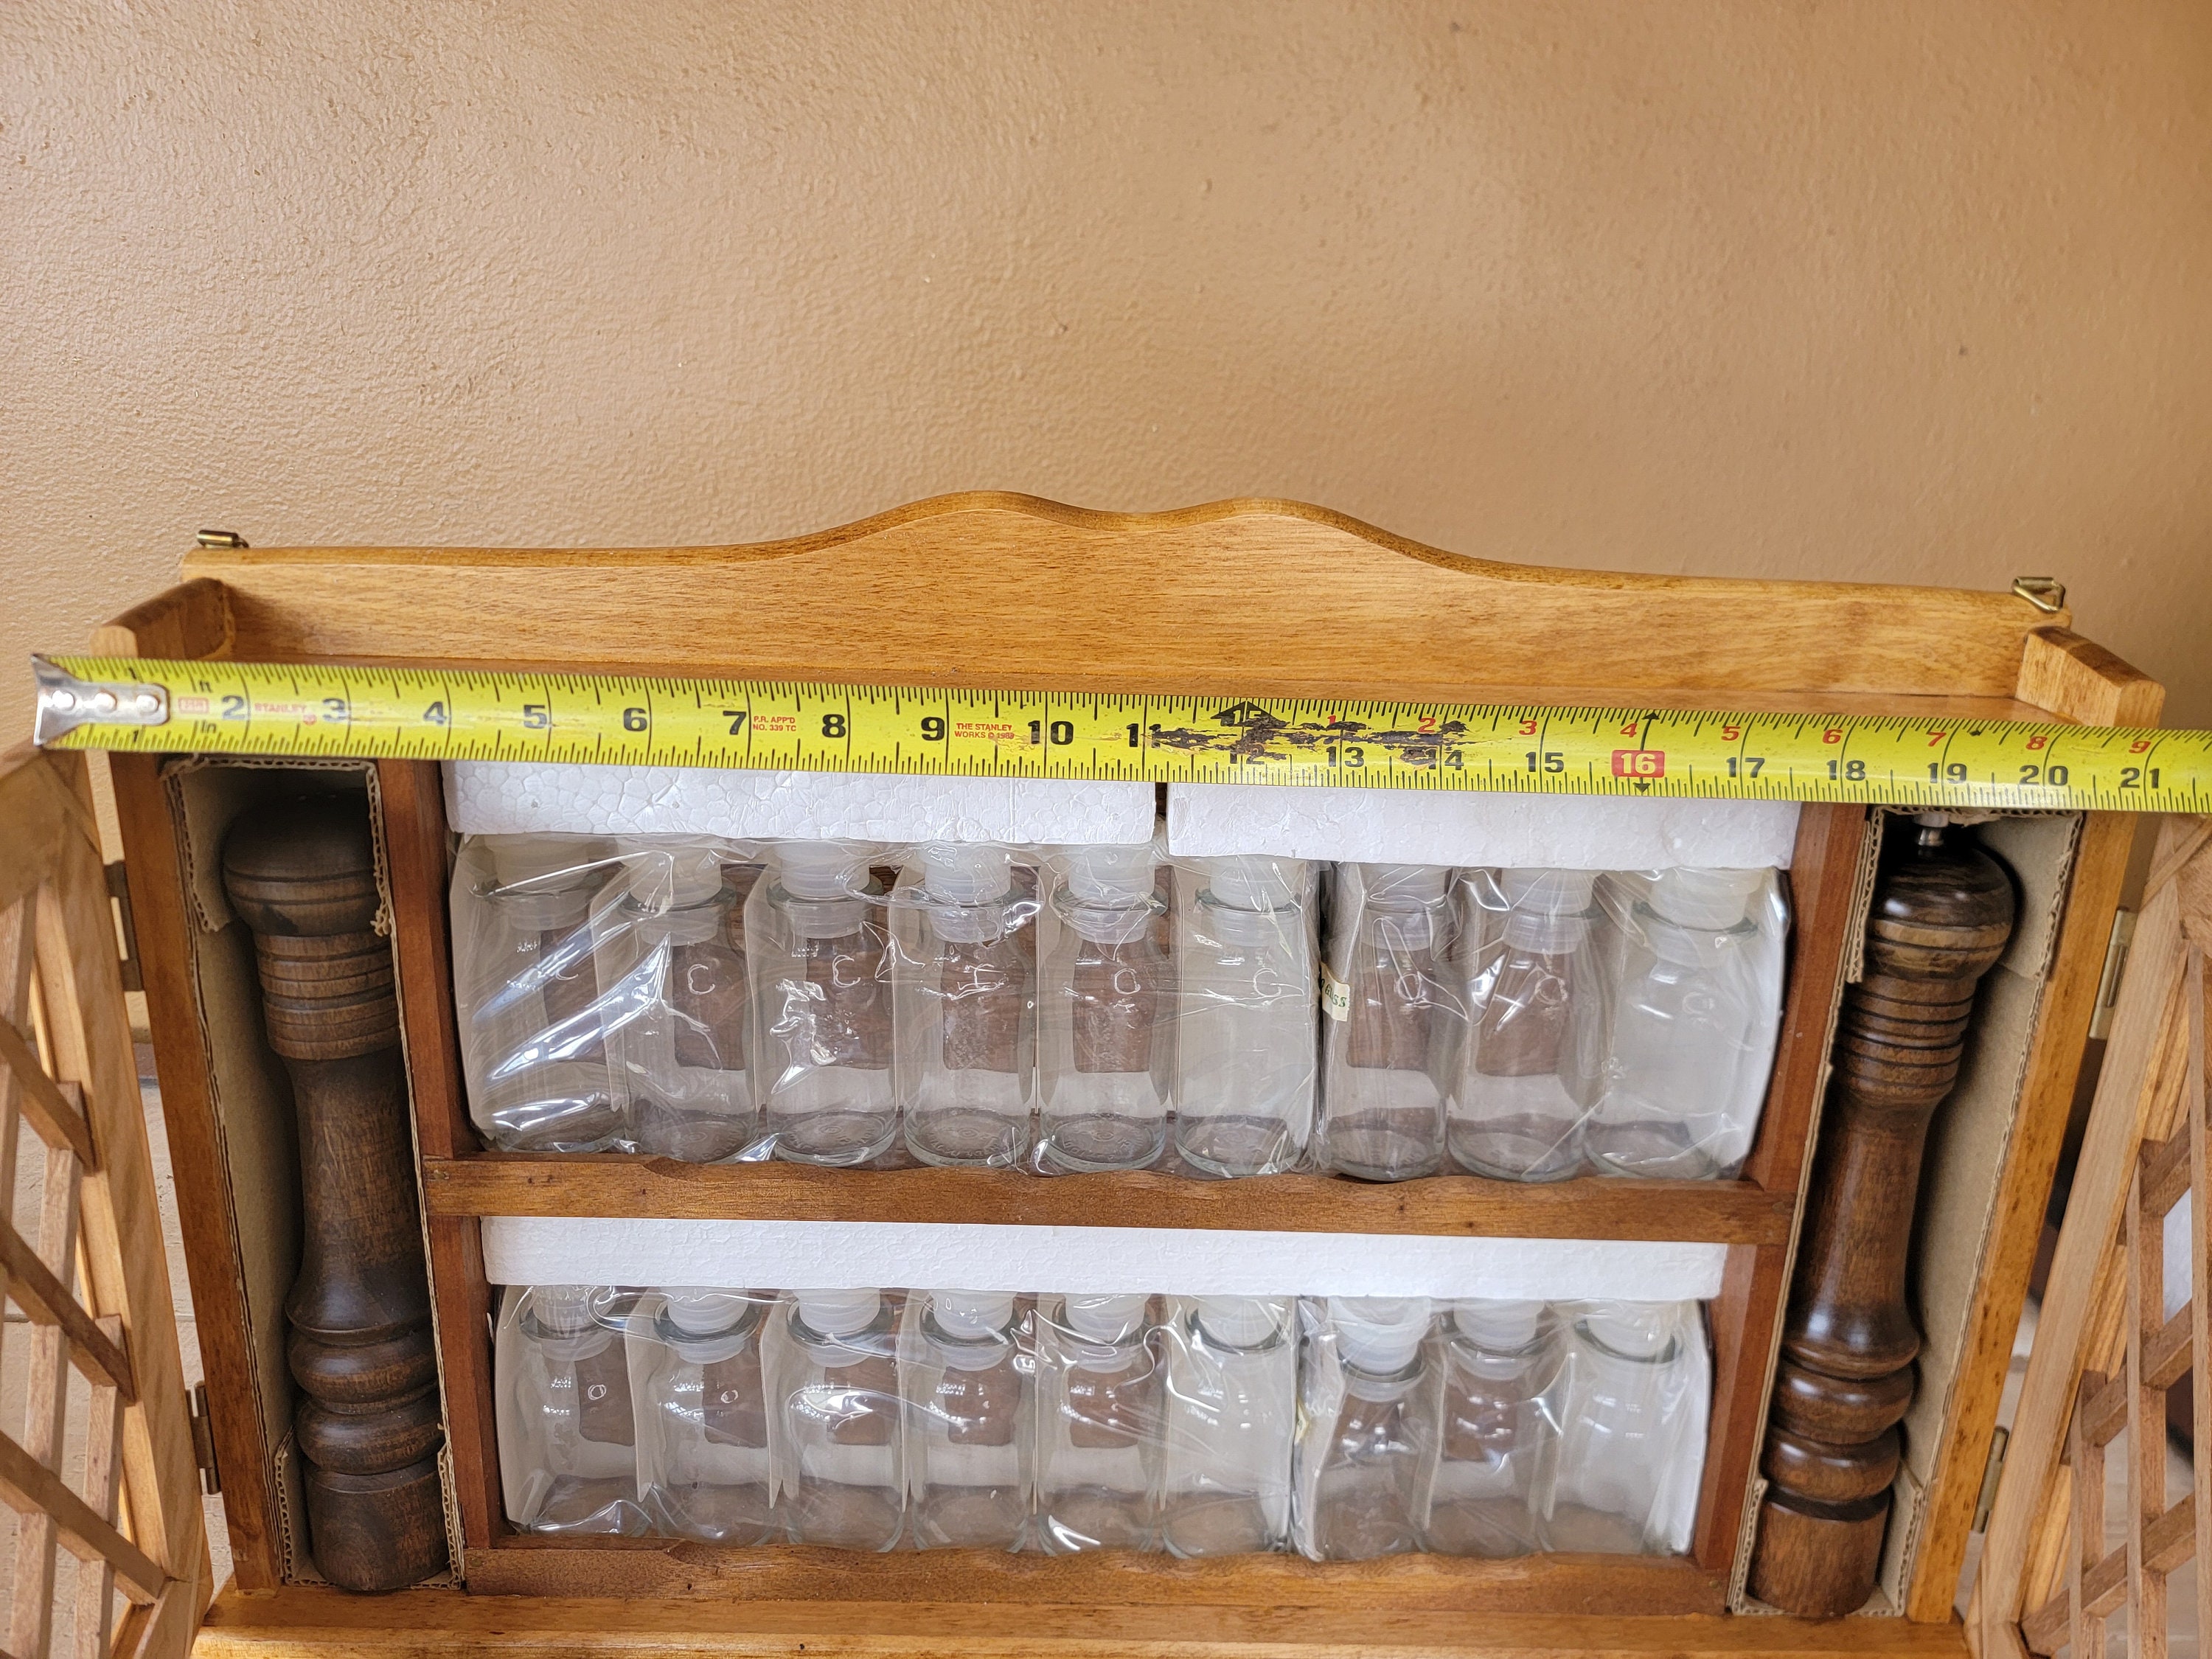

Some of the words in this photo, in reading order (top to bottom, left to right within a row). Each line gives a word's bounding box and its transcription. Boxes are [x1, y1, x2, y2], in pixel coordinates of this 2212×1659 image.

[223, 695, 244, 720] 2
[322, 698, 347, 723] 3
[422, 701, 447, 726] 4
[523, 704, 548, 729] 5
[622, 707, 648, 731] 6
[753, 715, 769, 723] P.R.
[722, 710, 747, 735] 7
[752, 723, 768, 731] NO.
[821, 714, 846, 738] 8
[921, 717, 945, 741] 9
[975, 723, 1012, 731] STANLEY
[1027, 720, 1074, 745] 10
[1417, 717, 1437, 734] 2
[1519, 720, 1537, 736] 3
[1620, 723, 1638, 738] 4
[1721, 726, 1742, 741] 5
[1822, 728, 1843, 744] 6
[1927, 731, 1947, 747] 7
[2025, 736, 2048, 751] 8
[2129, 740, 2151, 754] 9
[1326, 745, 1365, 768] 13
[1424, 748, 1464, 771] 14
[1526, 751, 1565, 773] 15
[1620, 752, 1656, 775] 16
[1725, 757, 1766, 779] 17
[1826, 759, 1866, 782] 18
[1927, 762, 1968, 785] 19
[2019, 764, 2069, 787] 20
[2120, 767, 2160, 789] 21
